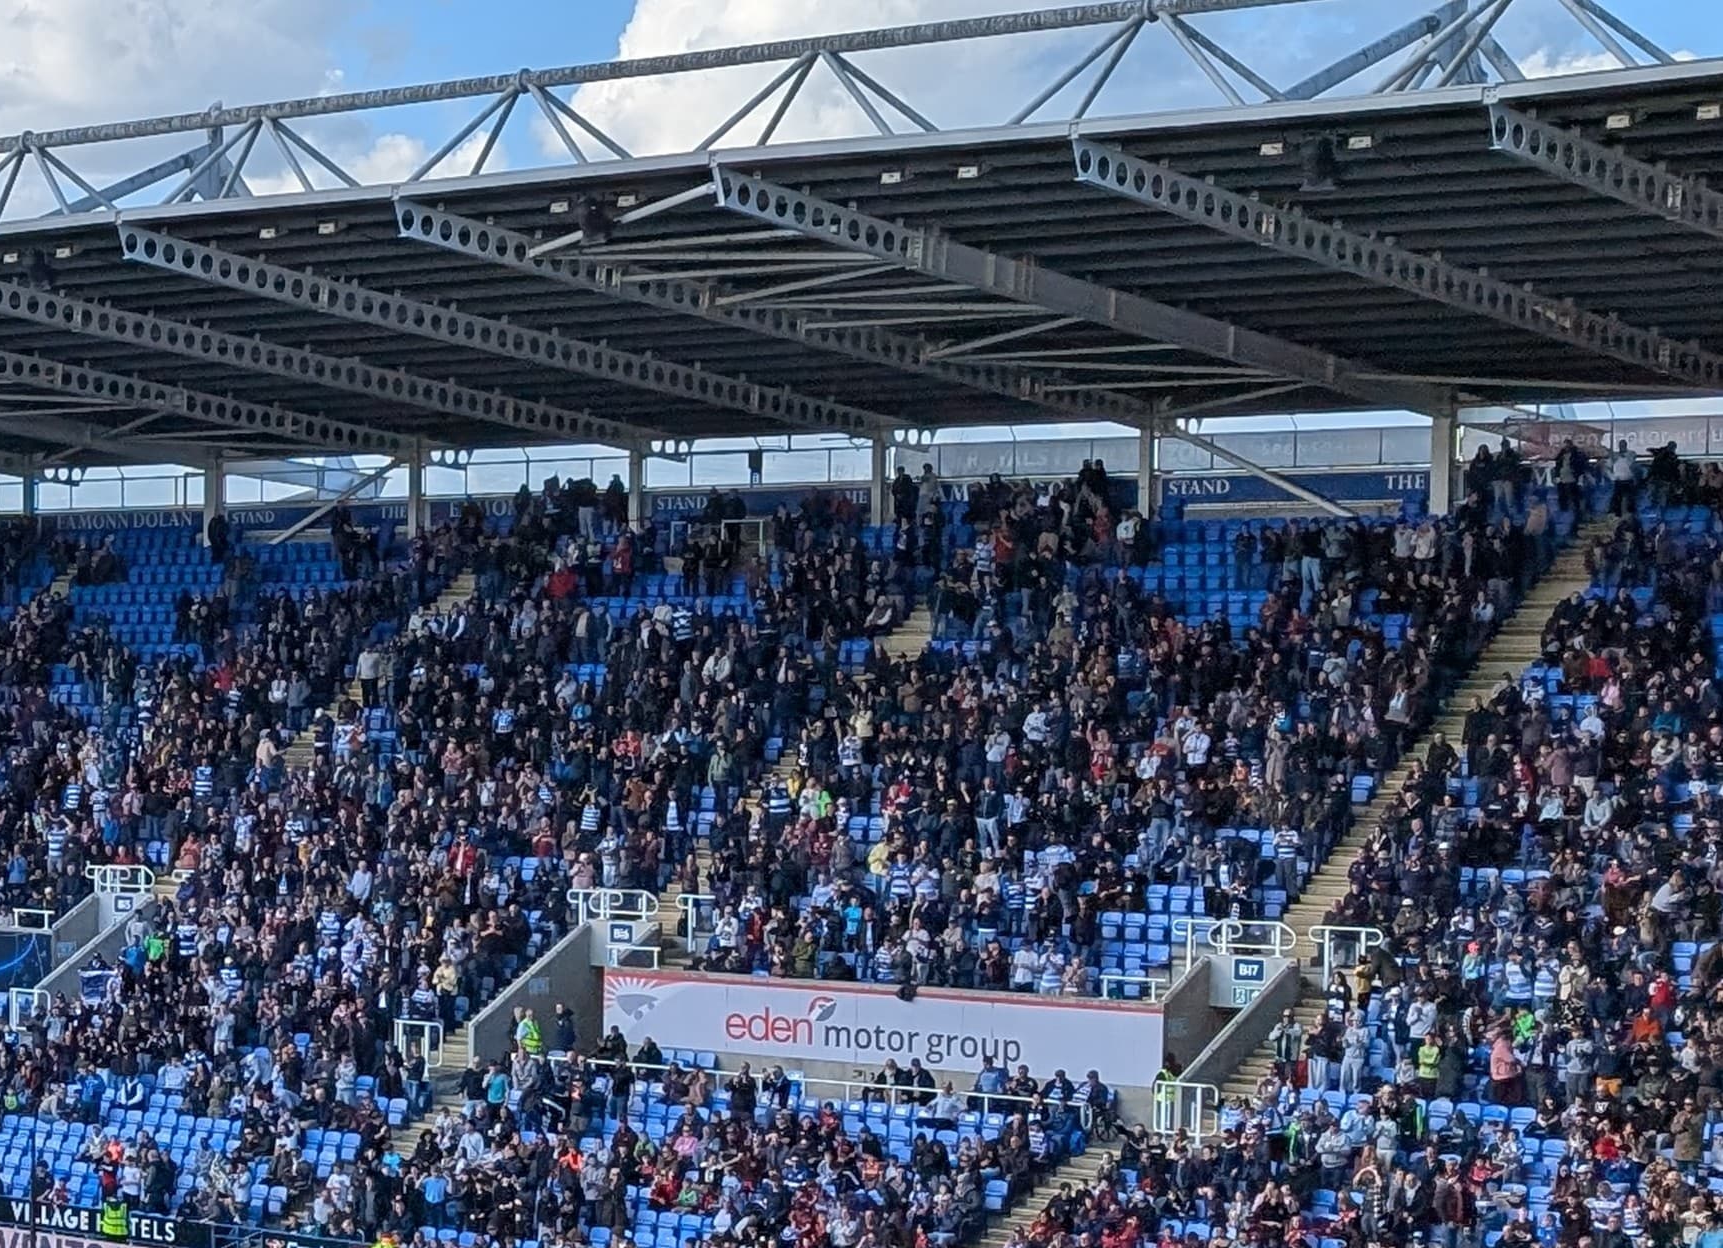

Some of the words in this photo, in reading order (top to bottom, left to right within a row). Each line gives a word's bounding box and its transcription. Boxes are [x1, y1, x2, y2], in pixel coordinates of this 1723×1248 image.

[1167, 479, 1231, 495] STAND
[1384, 474, 1425, 490] THE
[657, 496, 707, 510] STAND
[57, 513, 128, 530] EAMONN
[133, 511, 193, 528] DOLAN
[231, 510, 275, 525] STAND
[725, 1005, 813, 1046] eden
[824, 1025, 919, 1053] motor
[927, 1032, 1022, 1066] group
